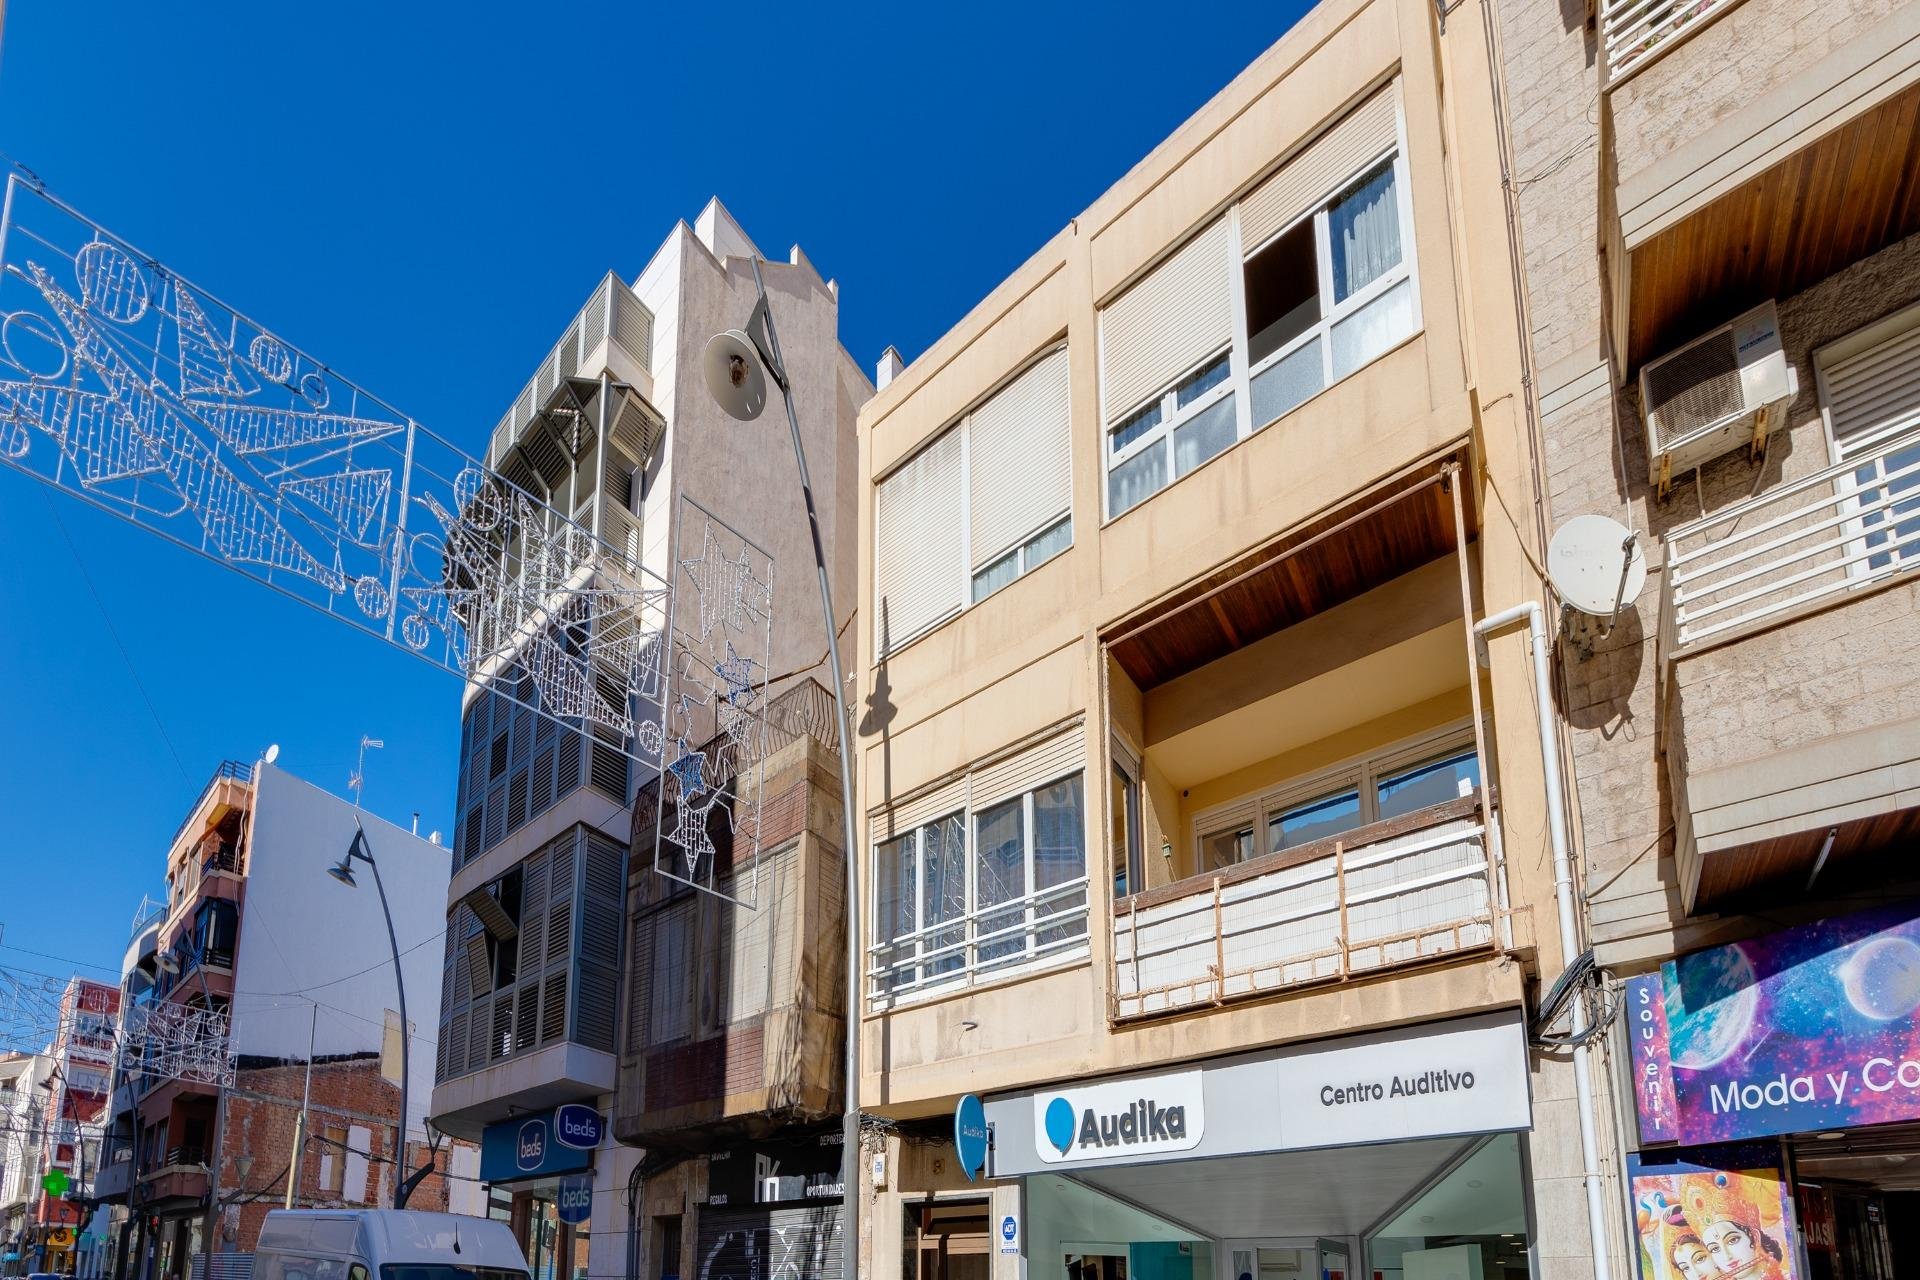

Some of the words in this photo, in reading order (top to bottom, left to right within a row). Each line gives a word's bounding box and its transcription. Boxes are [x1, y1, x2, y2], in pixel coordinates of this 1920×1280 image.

[1320, 1082, 1384, 1107] Centro
[1389, 1069, 1475, 1099] Auditivo
[1709, 1072, 1816, 1115] Moda
[1826, 1070, 1849, 1105] y
[565, 1115, 596, 1138] bed's
[1078, 1098, 1185, 1145] Audika
